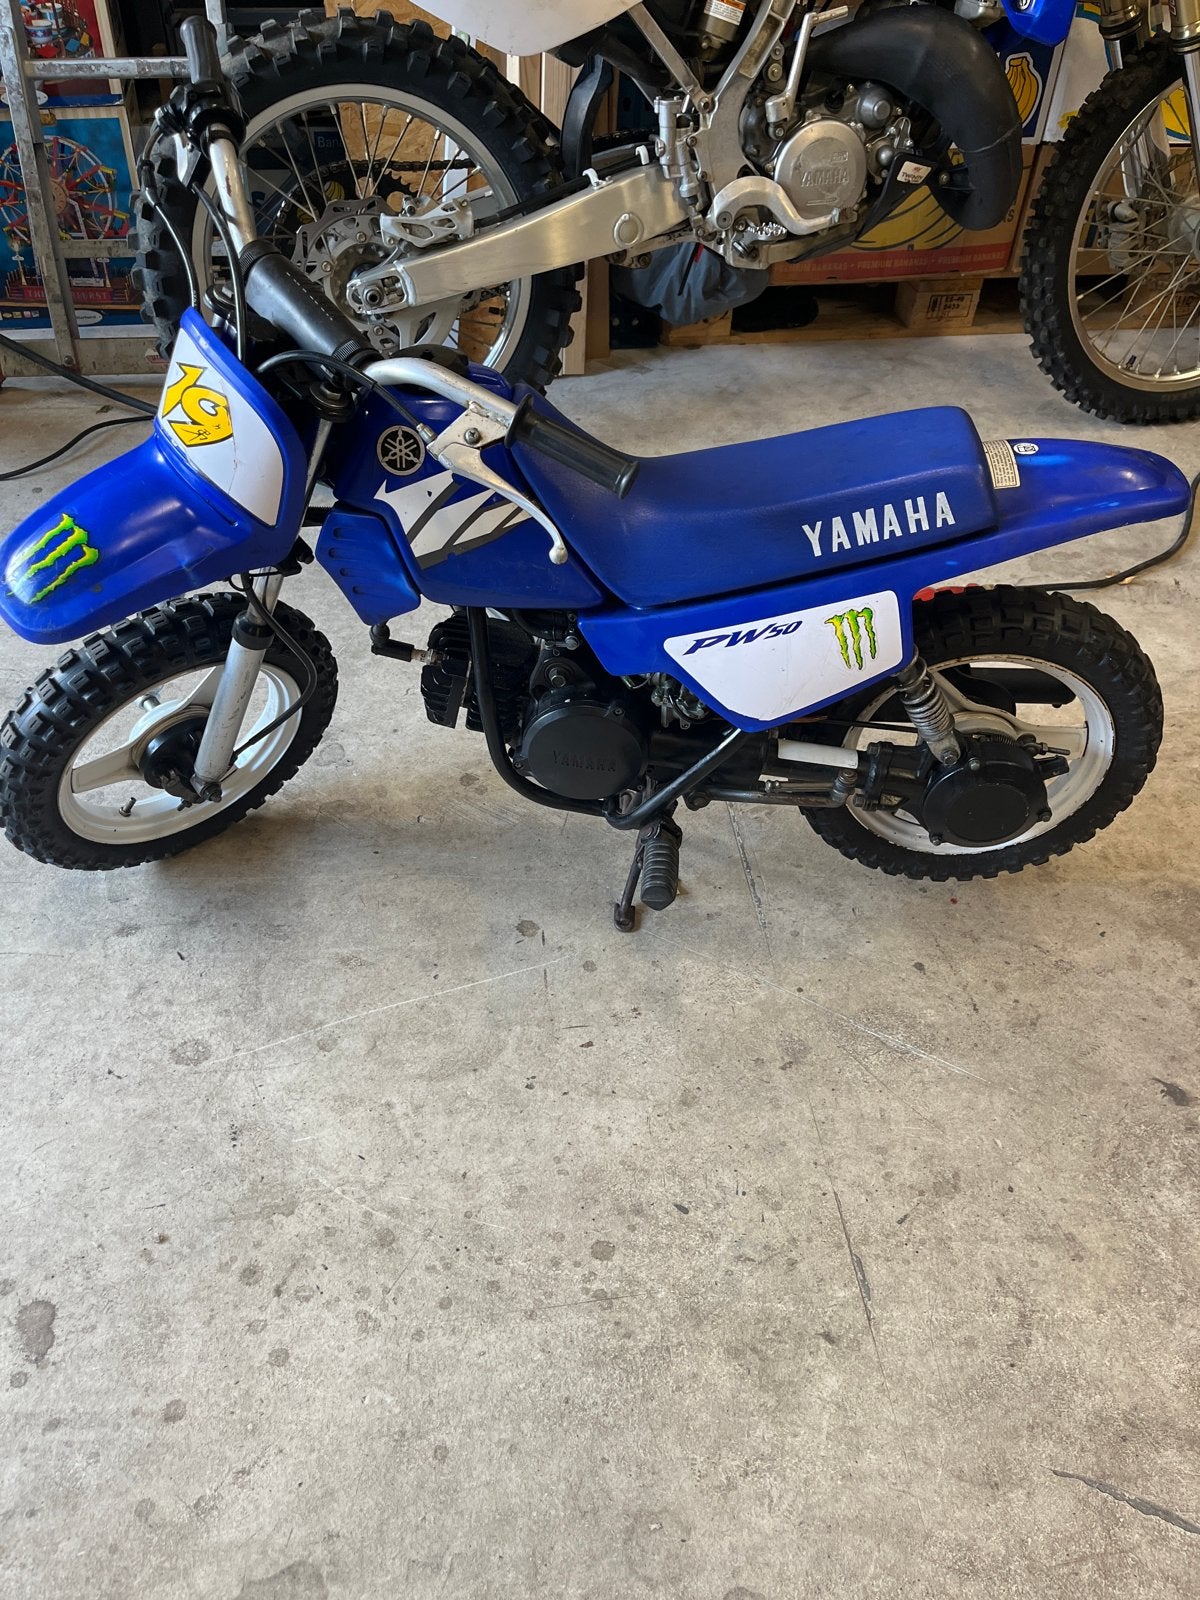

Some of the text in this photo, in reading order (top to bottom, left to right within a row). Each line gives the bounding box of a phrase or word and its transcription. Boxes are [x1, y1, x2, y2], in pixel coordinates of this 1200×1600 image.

[317, 135, 343, 149] Ban
[801, 165, 849, 188] YAMAHA
[857, 259, 894, 271] PREMIUM
[894, 255, 928, 267] BANANAS
[937, 253, 970, 265] PREMIUM
[970, 250, 1006, 263] BANANAS
[802, 491, 956, 557] YAMAHA
[683, 620, 803, 656] PW50
[552, 749, 617, 773] YAMAHA
